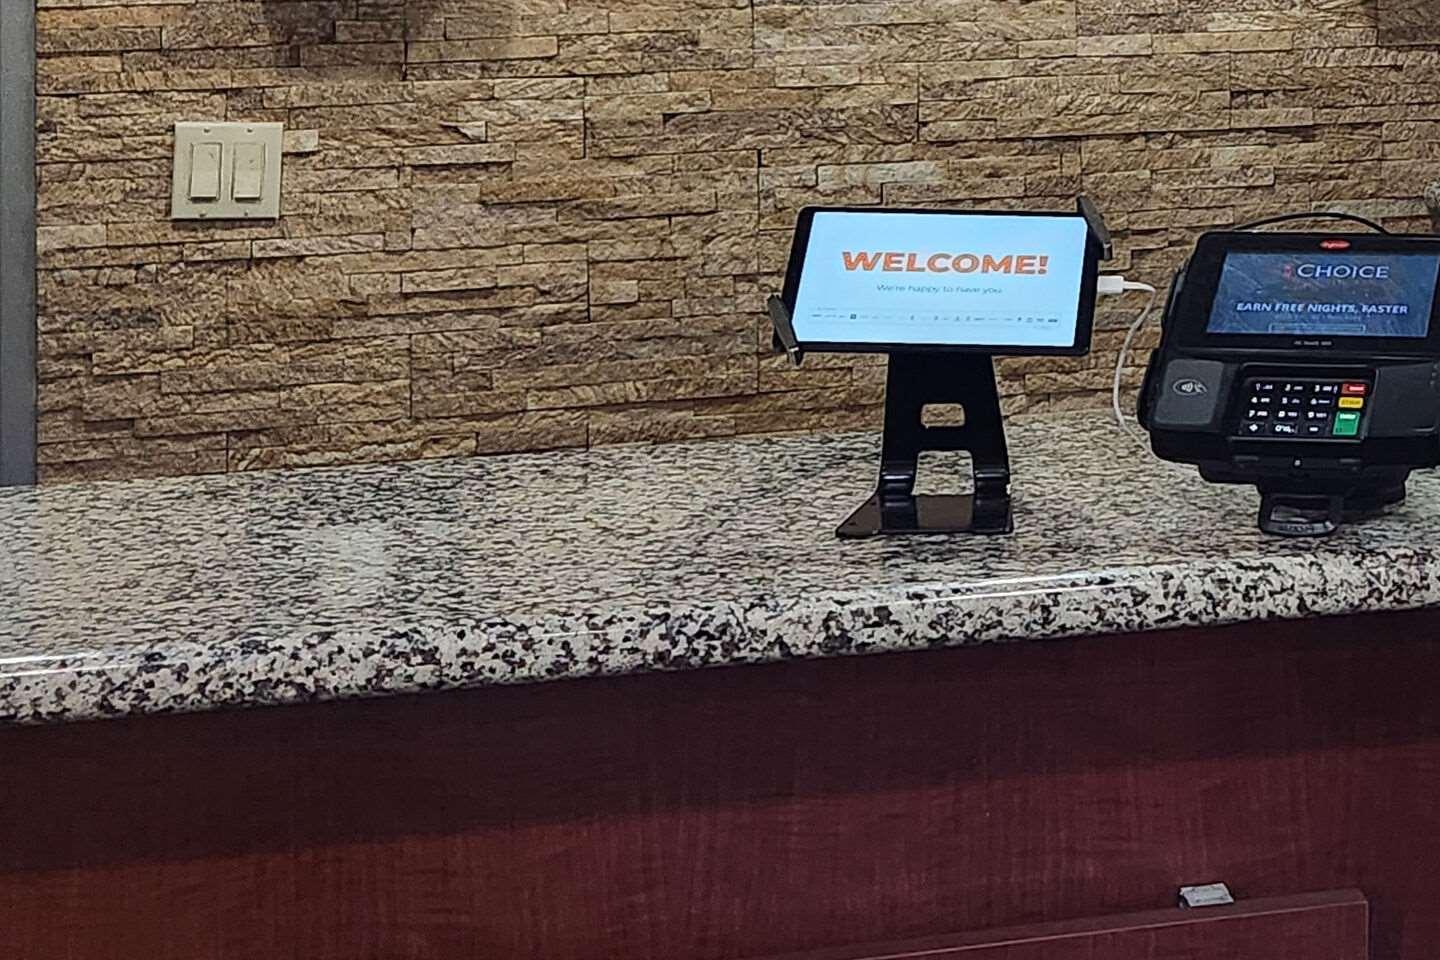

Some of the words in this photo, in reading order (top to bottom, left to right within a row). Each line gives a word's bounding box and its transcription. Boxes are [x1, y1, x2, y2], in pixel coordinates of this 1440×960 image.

[842, 251, 1049, 275] WELCOME!
[1297, 263, 1390, 279] CHOICE
[1236, 302, 1272, 312] EARN
[1274, 302, 1304, 313] FREE
[1361, 304, 1408, 314] FASTER
